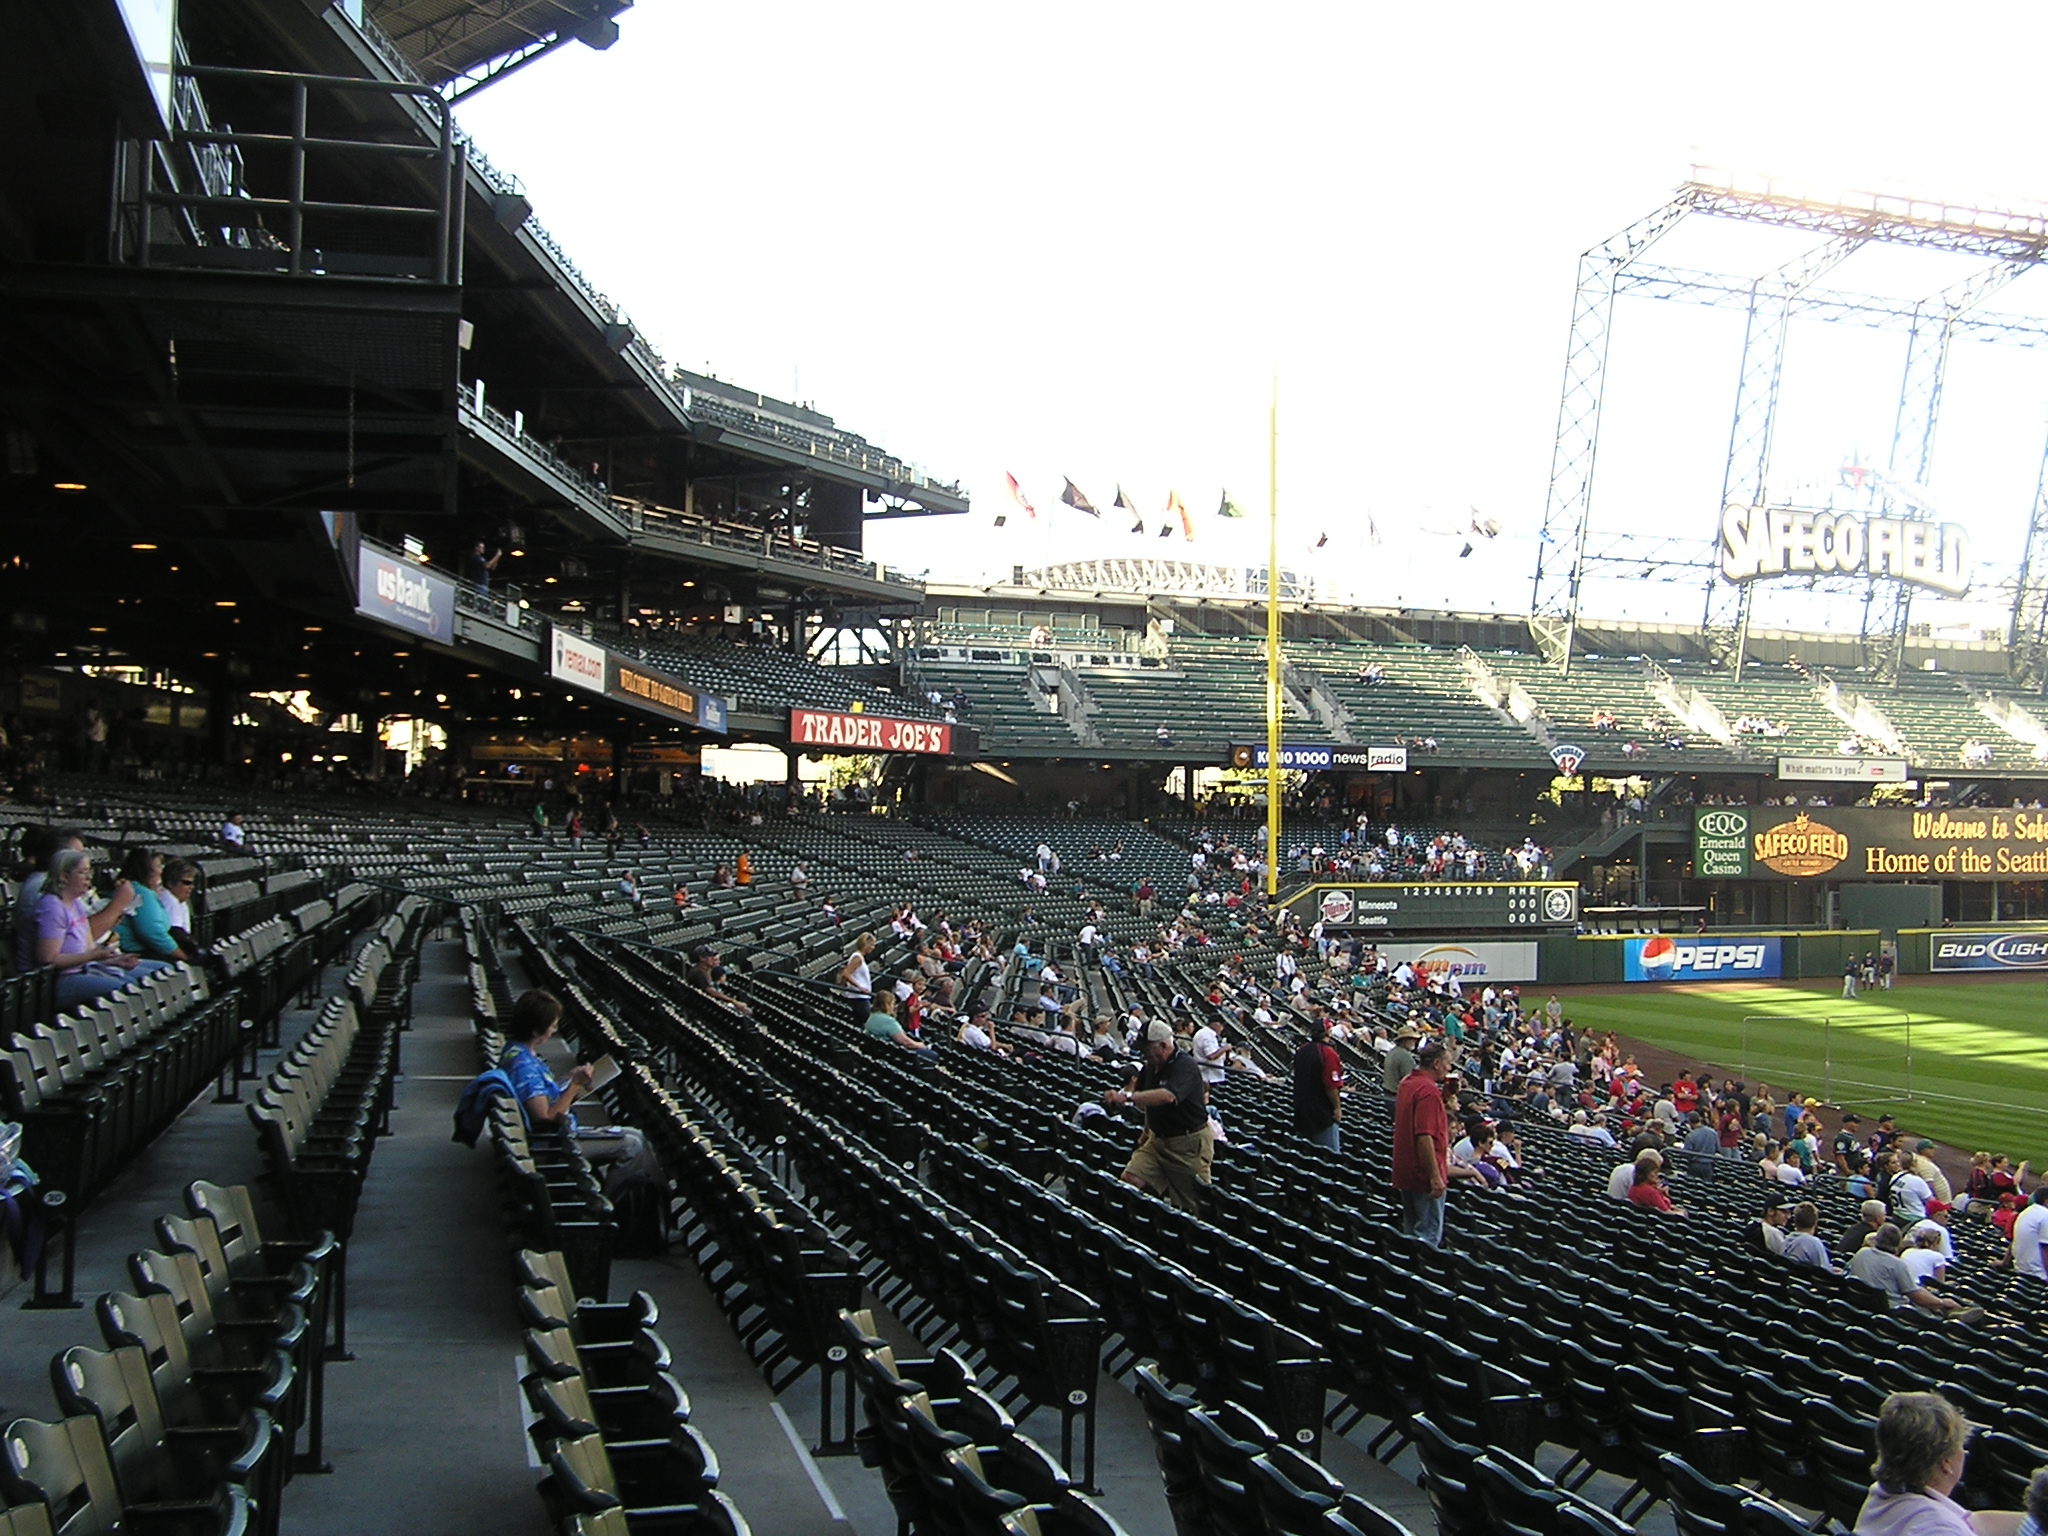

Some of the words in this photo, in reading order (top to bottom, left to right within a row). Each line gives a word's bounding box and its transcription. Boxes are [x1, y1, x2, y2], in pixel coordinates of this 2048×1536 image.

[1720, 502, 1865, 584] SAFECO
[1867, 517, 1971, 598] FIELD
[376, 567, 431, 613] usbank
[565, 649, 602, 680] remax.com
[801, 714, 882, 747] TRADER
[888, 722, 943, 752] JOE'S
[1295, 752, 1329, 764] 1000
[1333, 753, 1367, 764] news
[1371, 751, 1404, 764] radio
[1558, 757, 1576, 773] 42
[1785, 764, 1803, 773] What
[1805, 764, 1833, 774] matters
[1835, 766, 1843, 774] to
[1844, 760, 1864, 776] you?
[1705, 814, 1742, 835] EQC
[1912, 811, 1987, 839] Welcome
[1992, 815, 2010, 839] to
[1699, 837, 1745, 849] Emerald
[1754, 833, 1808, 861] SAFECO
[1809, 833, 1848, 861] FIELD
[1704, 850, 1740, 862] Queen
[1866, 847, 1929, 873] Home
[1934, 846, 1957, 873] of
[1960, 846, 1991, 873] the
[1703, 862, 1741, 875] Casino
[1403, 888, 1408, 896] 1
[1413, 888, 1419, 896] 2
[1424, 888, 1430, 896] 3
[1434, 888, 1440, 896] 4
[1445, 888, 1451, 896] 5
[1455, 888, 1462, 896] 6
[1466, 888, 1472, 896] 7
[1476, 888, 1482, 896] 8
[1487, 888, 1494, 896] 9
[1509, 887, 1516, 895] R
[1520, 887, 1526, 895] H
[1530, 887, 1536, 895] E
[1358, 901, 1398, 910] Minnesota
[1509, 899, 1516, 909] 0
[1520, 899, 1526, 909] 0
[1530, 899, 1536, 909] 0
[1358, 915, 1388, 925] Seattle
[1509, 913, 1516, 923] 0
[1520, 913, 1526, 923] 0
[1530, 913, 1536, 923] 0
[1672, 945, 1765, 970] PEPSI
[1938, 943, 1986, 957] BUD
[831, 1349, 843, 1357] 27
